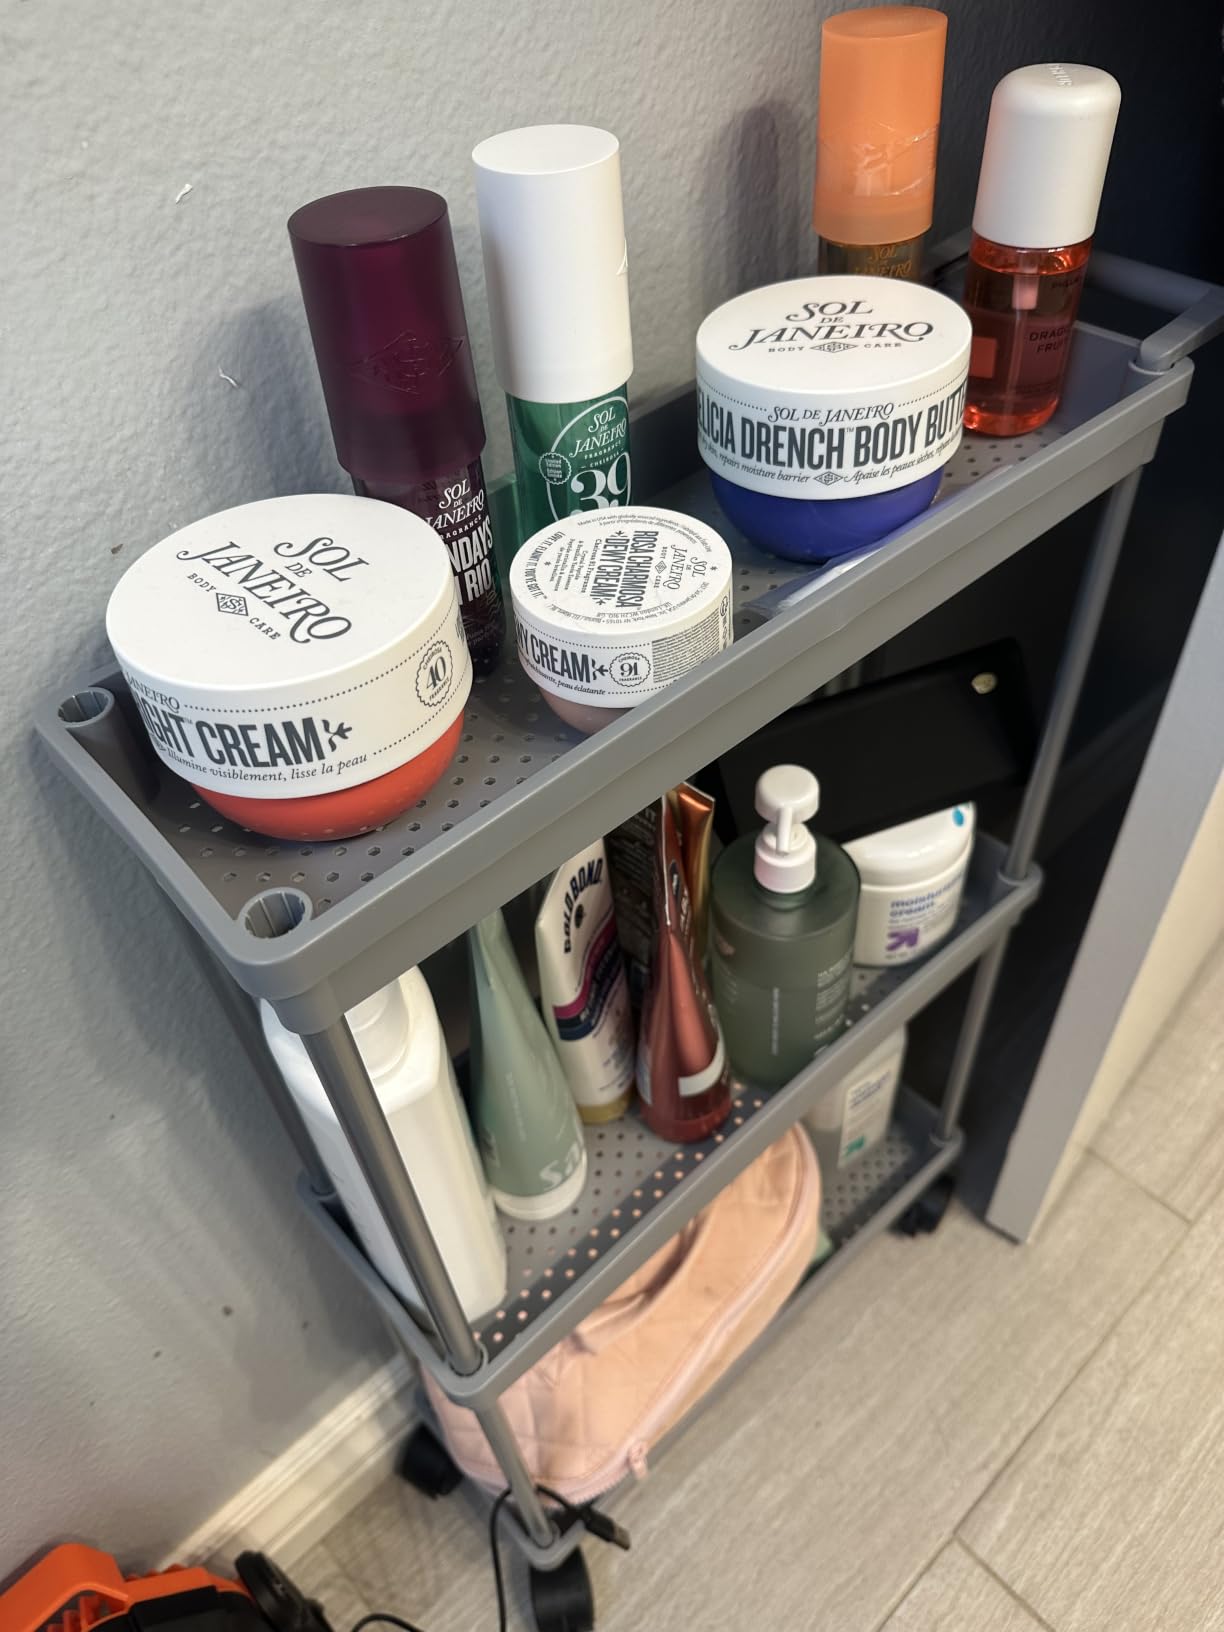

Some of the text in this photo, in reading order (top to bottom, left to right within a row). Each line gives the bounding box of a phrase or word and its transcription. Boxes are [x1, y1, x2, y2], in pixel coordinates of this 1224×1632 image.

[785, 300, 873, 322] SOL
[819, 316, 844, 324] DE
[728, 322, 934, 351] JANEIRO
[1029, 327, 1067, 342] DRAG
[588, 406, 616, 433] SOL
[767, 402, 895, 427] SOL DE JANEIRO
[569, 417, 627, 458] JANEIRO
[741, 416, 845, 470] DRENCH
[853, 410, 923, 468] BODY
[719, 453, 740, 469] repairs
[741, 464, 776, 480] moisture
[777, 472, 811, 483] barrier
[843, 470, 880, 485] Apaise
[880, 465, 890, 476] les
[438, 478, 471, 509] SOL
[453, 499, 463, 508] DE
[440, 515, 482, 540] AGRANCE
[273, 536, 369, 582] SOL
[445, 515, 493, 573] NDAYS
[284, 562, 313, 578] DE
[464, 558, 492, 602] RIO
[589, 538, 630, 597] DEWY CREAM
[615, 530, 659, 608] ROSA CHARMOSA
[662, 544, 688, 589] JANEIRO
[690, 556, 708, 577] SOL
[176, 541, 352, 644] JANEIRO
[187, 572, 281, 640] BODY CARE
[426, 656, 447, 689] 40
[530, 633, 591, 684] CREAM
[620, 661, 640, 677] 91
[557, 679, 573, 688] peau
[574, 684, 607, 696] éclatante
[135, 691, 325, 768] IGHT CREAM
[209, 763, 287, 782] visiblement,
[291, 766, 317, 780] lisse
[321, 763, 334, 775] la
[336, 753, 368, 776] peau
